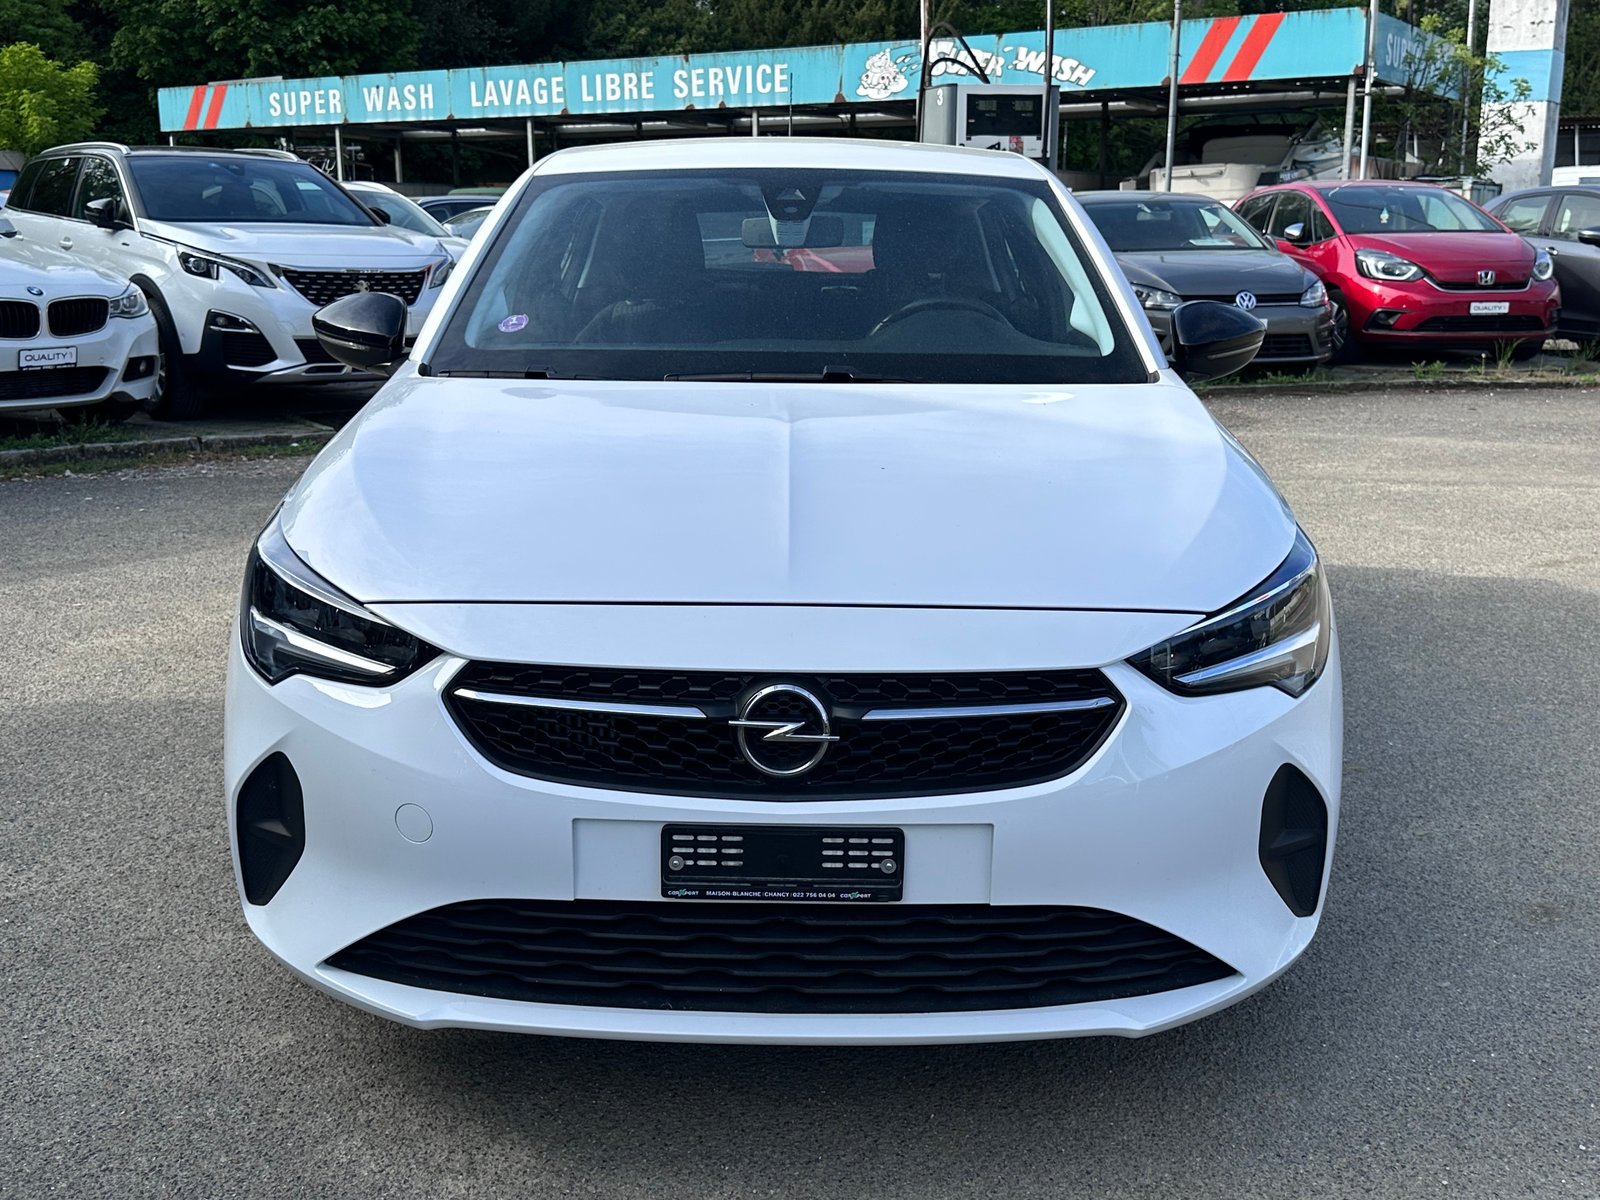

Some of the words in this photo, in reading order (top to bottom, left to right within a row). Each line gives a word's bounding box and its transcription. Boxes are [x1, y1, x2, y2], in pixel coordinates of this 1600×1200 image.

[928, 40, 1005, 77] SUPER
[1013, 46, 1096, 87] WASH
[269, 88, 342, 117] SUPER
[363, 84, 434, 112] WASH
[470, 76, 564, 107] LAVAGE
[581, 71, 655, 102] LIBRE
[673, 63, 789, 98] SERVICE
[936, 88, 944, 106] 3
[25, 352, 67, 361] QUALITY
